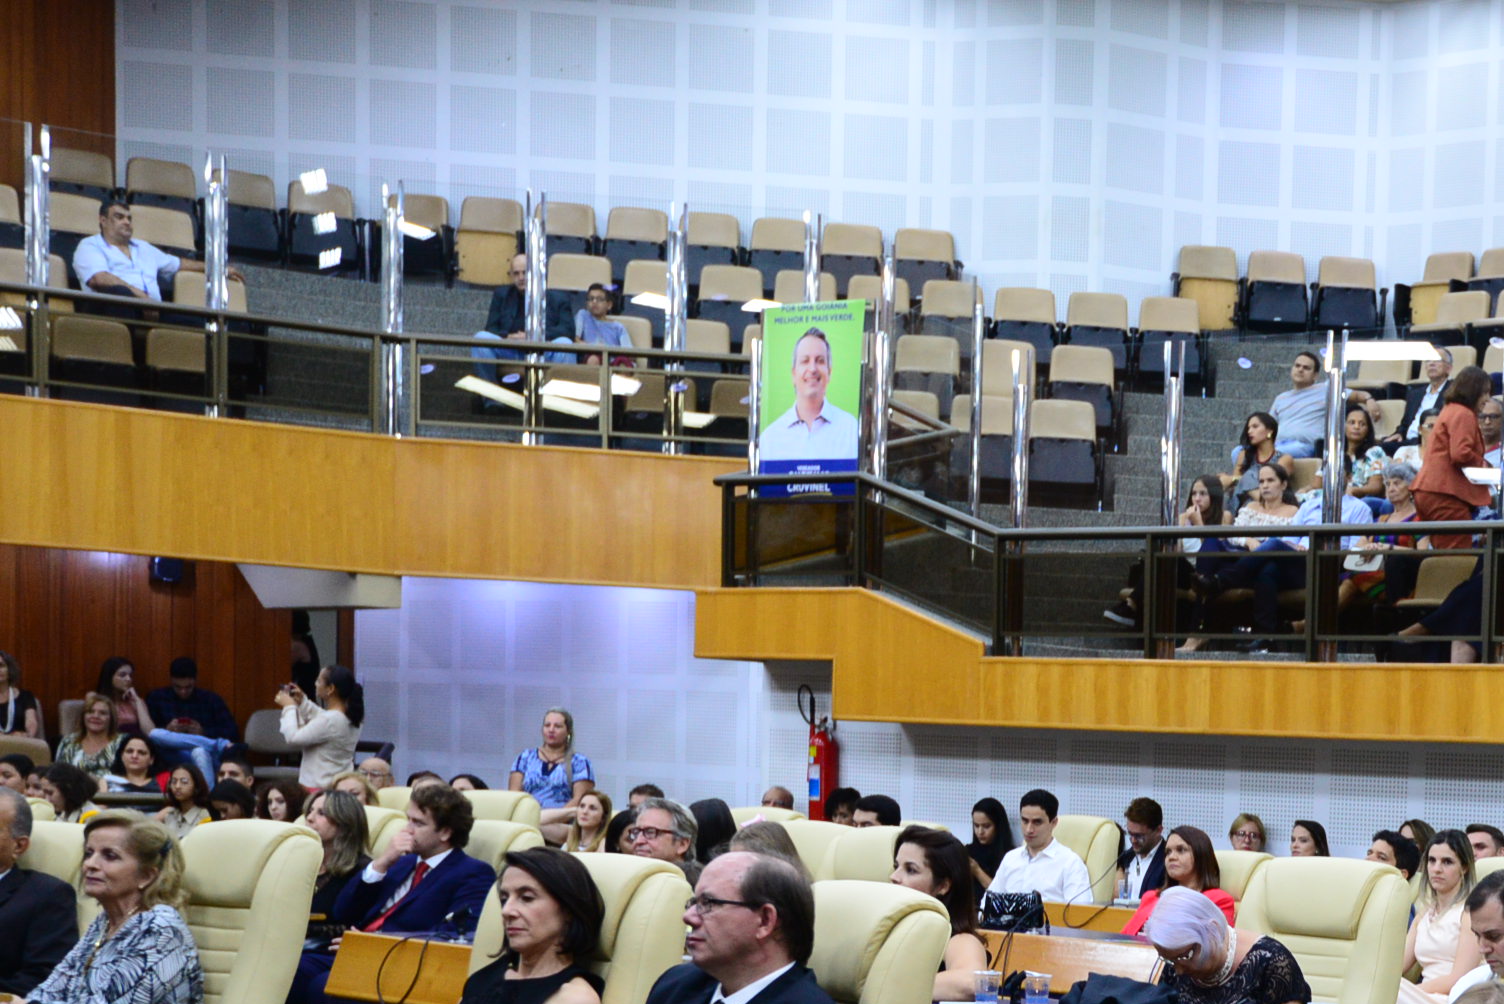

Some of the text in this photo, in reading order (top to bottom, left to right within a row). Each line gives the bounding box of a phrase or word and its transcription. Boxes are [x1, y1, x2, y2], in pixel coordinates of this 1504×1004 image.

[781, 304, 795, 313] POR
[797, 304, 814, 312] UMA
[774, 316, 803, 324] MELHOR
[811, 314, 829, 322] MAIS
